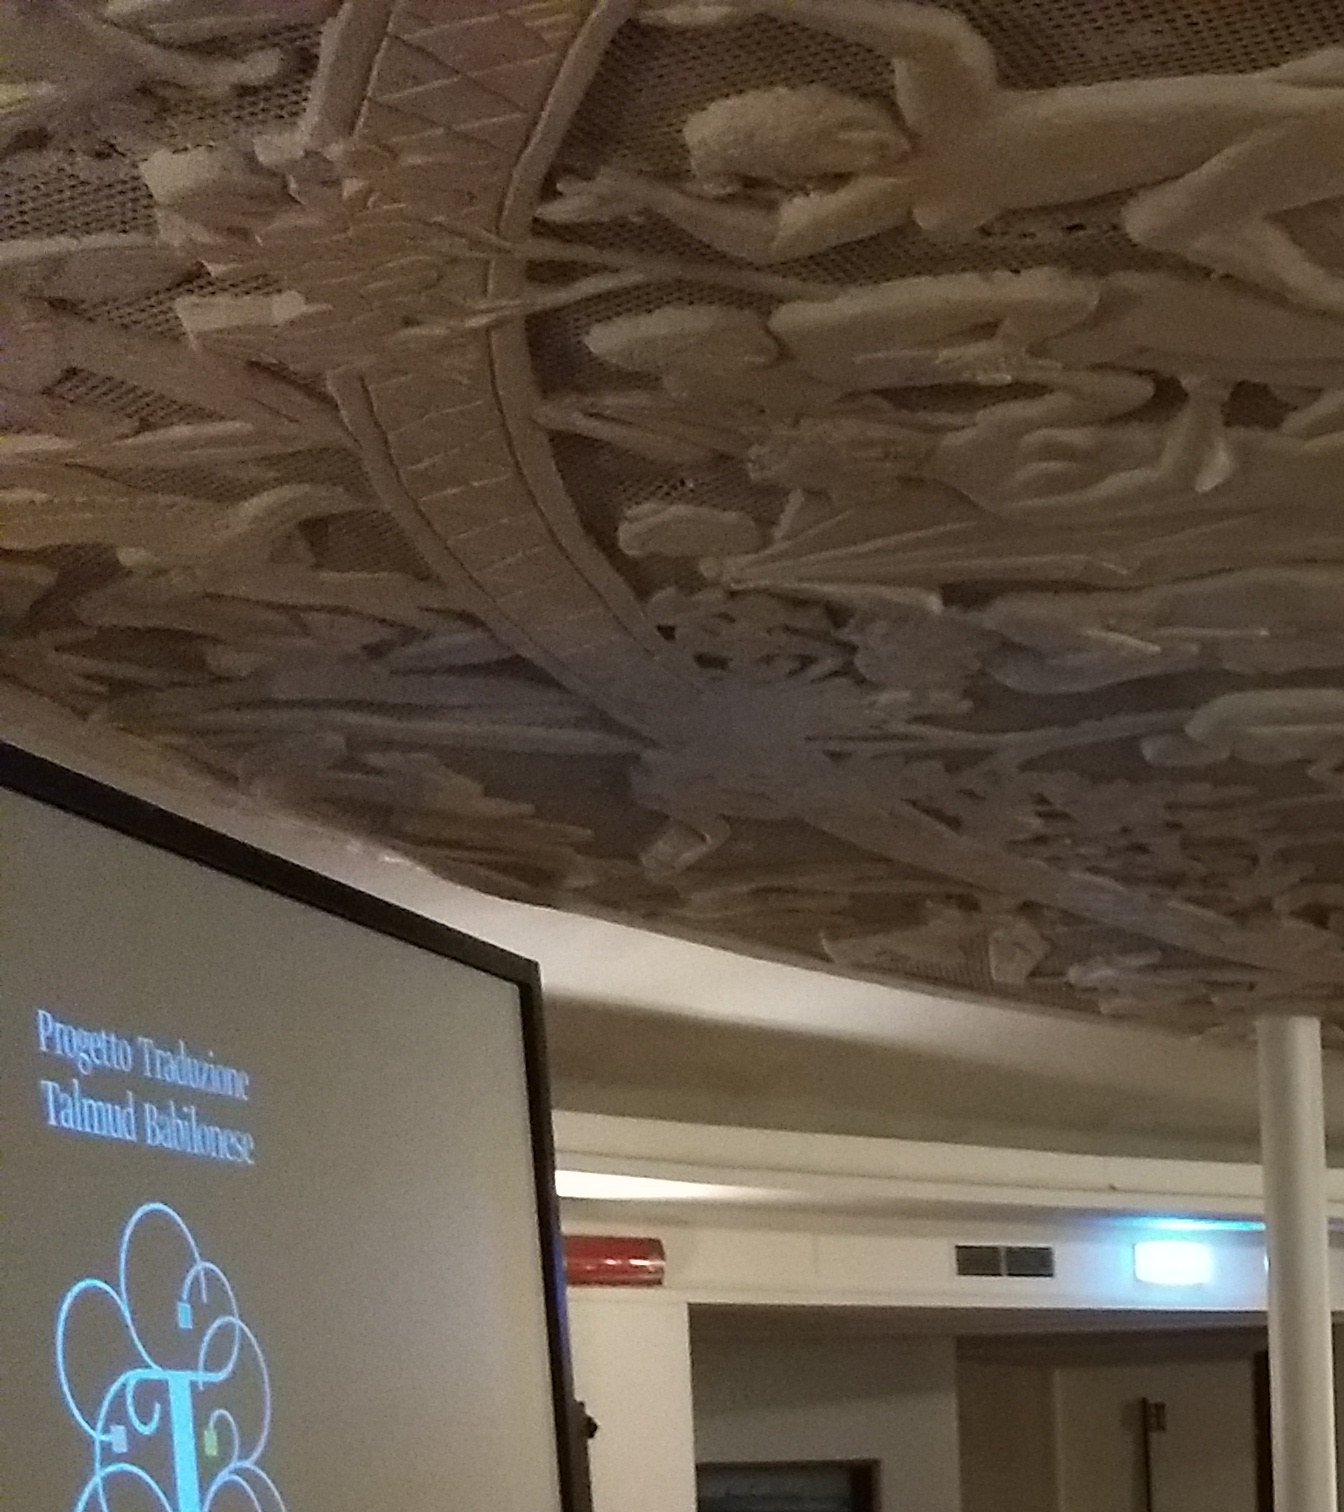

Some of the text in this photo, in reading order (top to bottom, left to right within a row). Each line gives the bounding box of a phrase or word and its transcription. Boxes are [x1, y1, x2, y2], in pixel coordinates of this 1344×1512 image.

[37, 1009, 249, 1100] Progetto Traduzione
[41, 1078, 255, 1164] Talmud Babilonese
